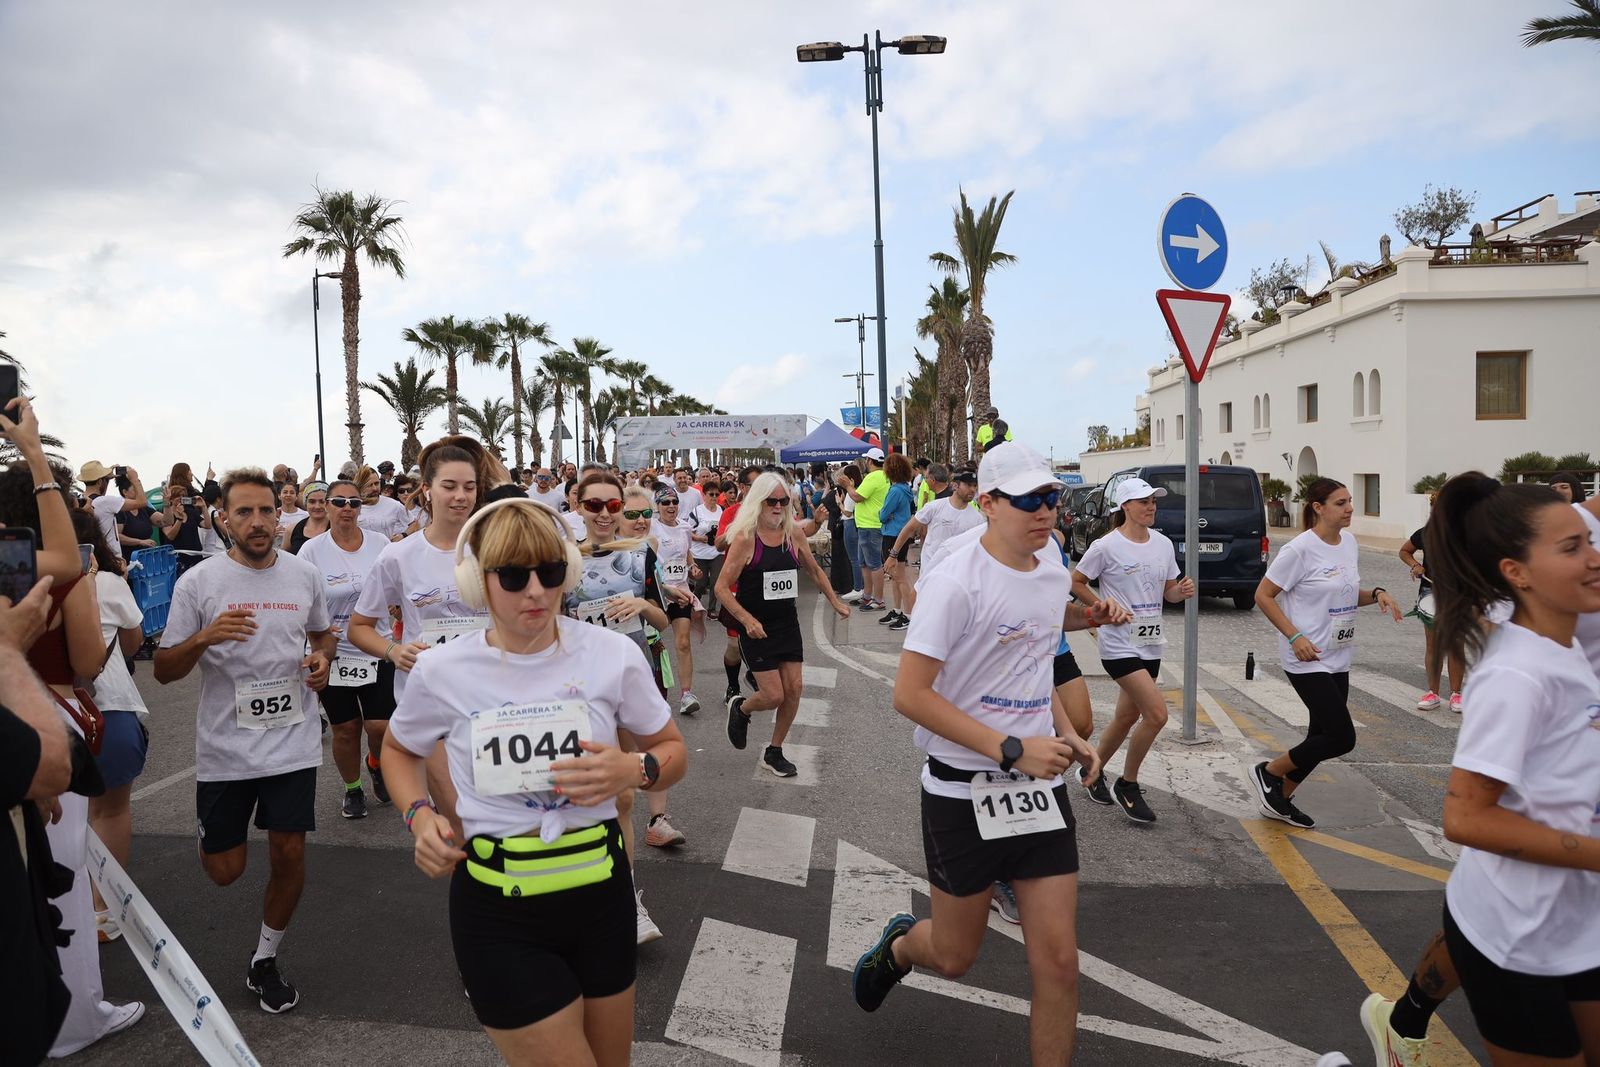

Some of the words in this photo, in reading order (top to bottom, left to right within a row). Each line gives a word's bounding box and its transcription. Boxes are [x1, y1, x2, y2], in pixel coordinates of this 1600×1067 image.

[676, 421, 688, 429] 3A
[689, 420, 732, 429] CARRERA
[733, 420, 745, 428] 5K
[1206, 544, 1220, 552] HNR
[771, 580, 792, 592] 900
[1138, 625, 1160, 636] 275
[1338, 628, 1354, 640] 848
[340, 666, 368, 678] 643
[250, 694, 292, 716] 952
[510, 706, 550, 716] CARRERA
[483, 730, 584, 766] 1044
[981, 790, 1049, 818] 1130
